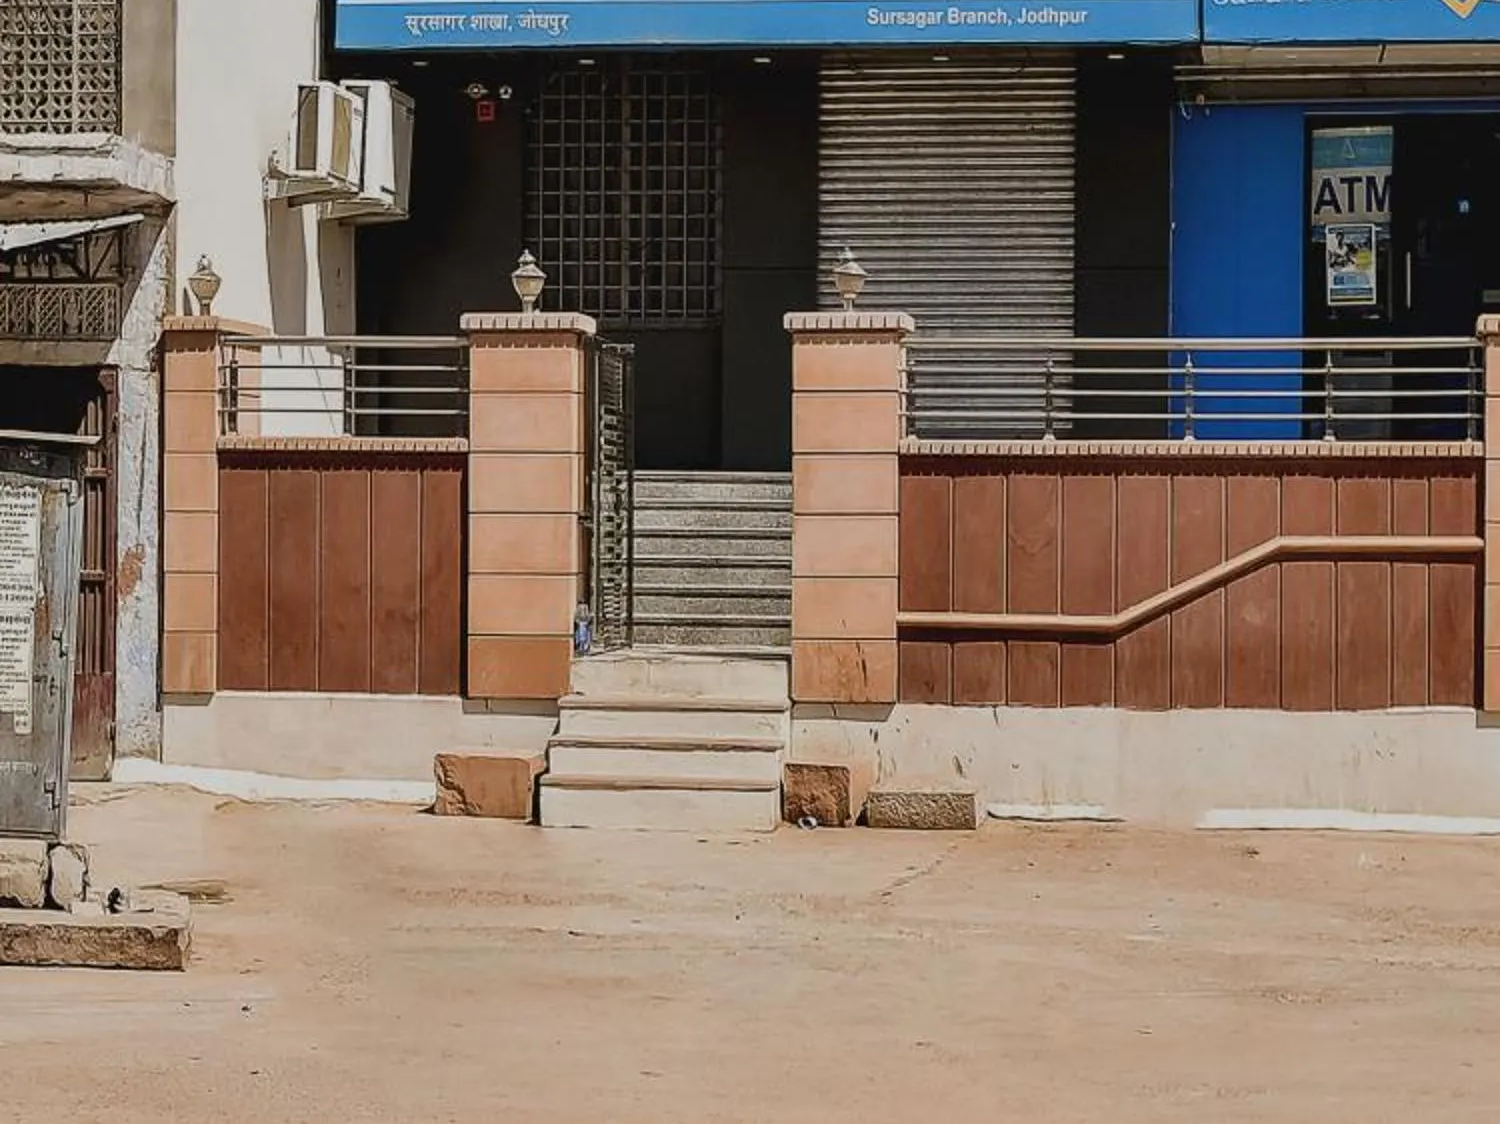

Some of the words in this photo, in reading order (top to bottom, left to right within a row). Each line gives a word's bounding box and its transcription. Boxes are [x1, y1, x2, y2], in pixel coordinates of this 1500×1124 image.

[867, 7, 944, 29] Sursagar
[947, 7, 1012, 25] Branch,
[1017, 7, 1088, 27] Jodhpur
[1314, 176, 1391, 215] ATM
